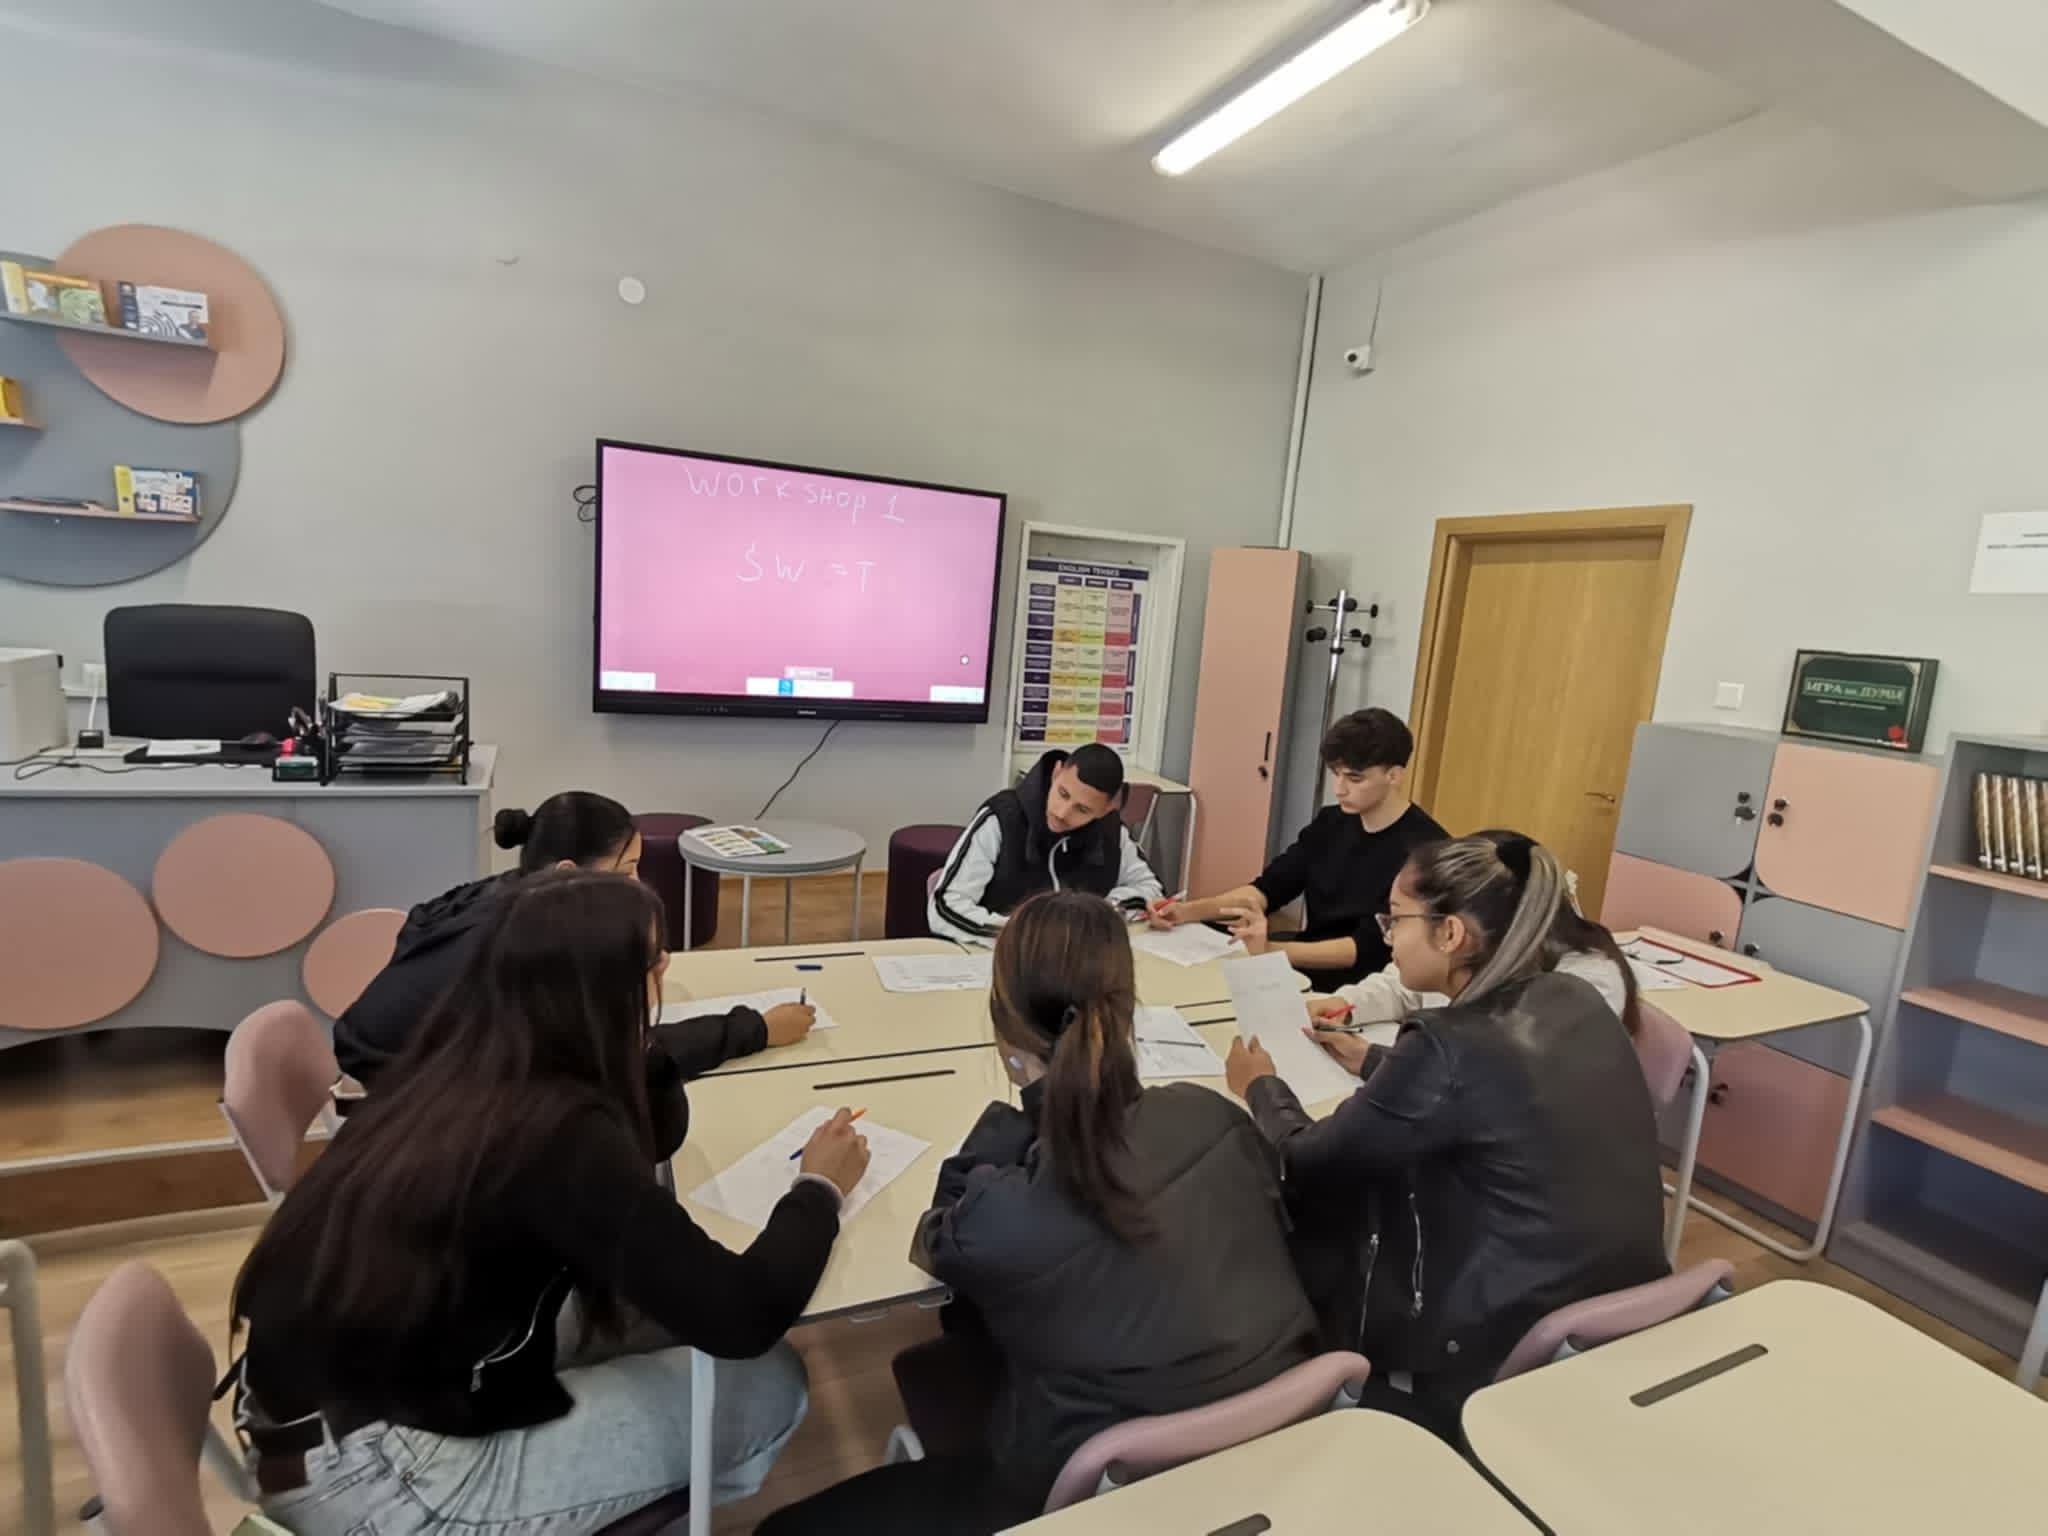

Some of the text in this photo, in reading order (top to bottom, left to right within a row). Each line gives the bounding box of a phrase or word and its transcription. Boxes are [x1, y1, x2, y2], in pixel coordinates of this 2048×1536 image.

[880, 493, 905, 524] 1
[1058, 564, 1120, 577] ENGLISH TENSES
[1807, 681, 1842, 694] ИГРА
